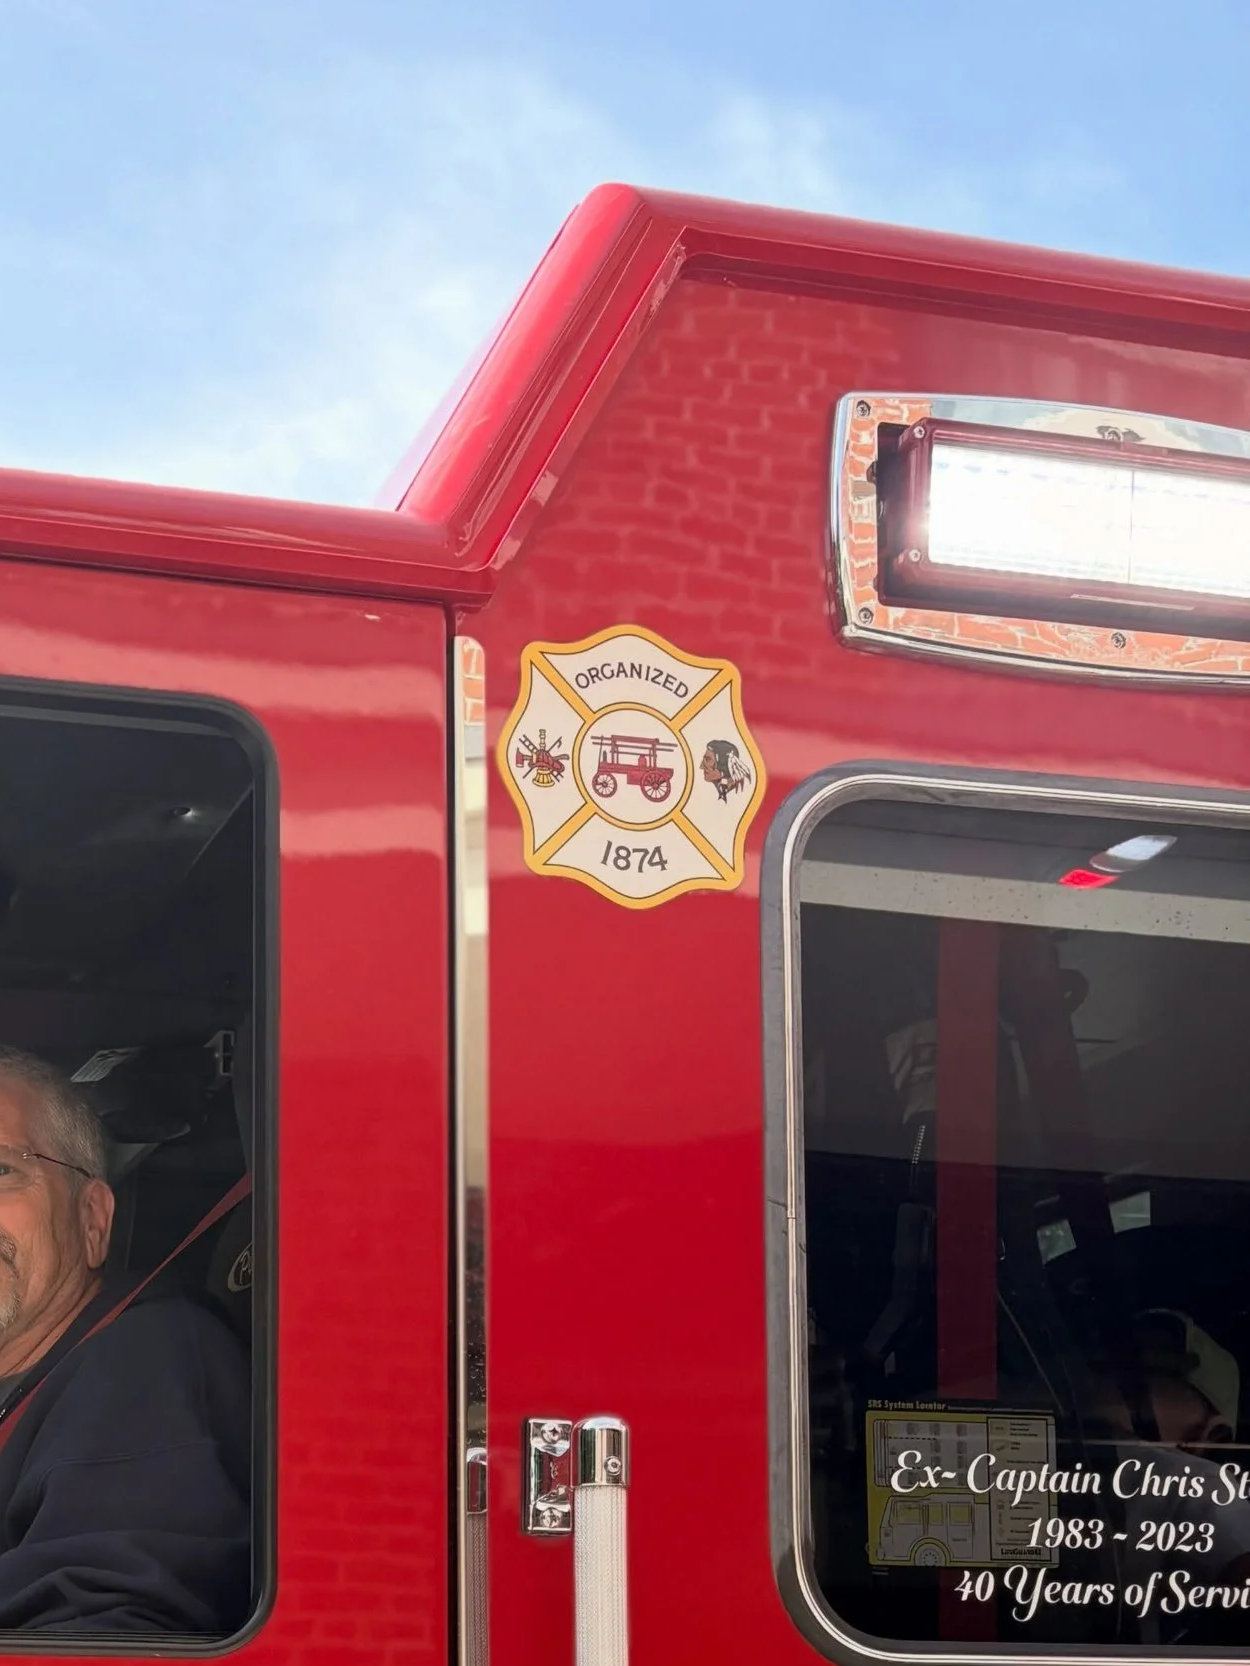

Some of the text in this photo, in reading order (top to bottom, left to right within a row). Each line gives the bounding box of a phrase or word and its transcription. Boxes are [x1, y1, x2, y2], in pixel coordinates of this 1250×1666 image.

[574, 661, 689, 698] ORGANIZED
[601, 840, 668, 873] 1874
[883, 1400, 914, 1410] System
[890, 1450, 956, 1493] Ex-
[967, 1453, 1102, 1507] Captain
[1112, 1459, 1204, 1499] Chris
[1026, 1517, 1104, 1550] 1983
[1136, 1520, 1215, 1554] 2023
[954, 1571, 995, 1602] 40
[1004, 1564, 1115, 1623] Years
[1124, 1571, 1162, 1618] of
